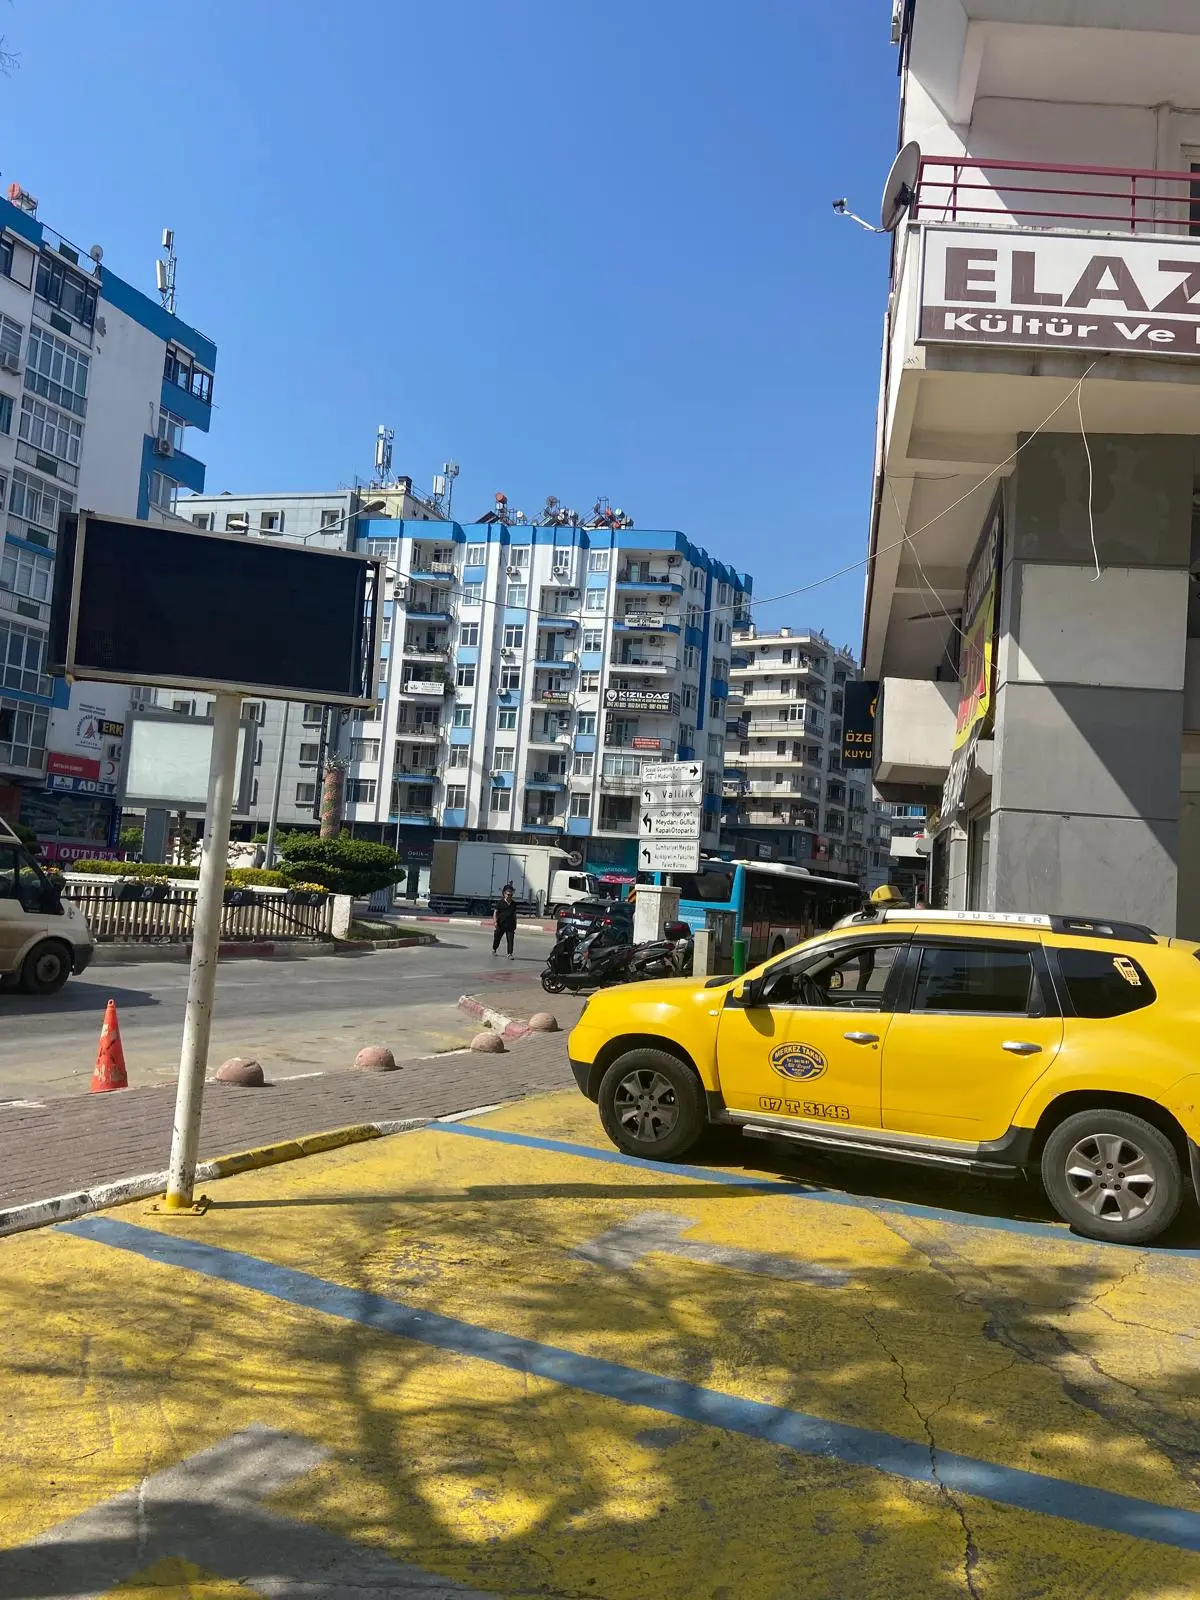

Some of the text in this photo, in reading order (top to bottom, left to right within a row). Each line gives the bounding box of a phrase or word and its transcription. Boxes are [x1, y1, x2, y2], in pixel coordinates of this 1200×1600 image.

[944, 312, 1176, 344] Kültür Ve
[846, 730, 872, 742] ÖZG
[845, 750, 872, 759] KUYU
[662, 789, 694, 799] Valilik
[660, 809, 693, 819] Cumhuriyet
[60, 848, 117, 860] OUTLET
[958, 912, 1042, 923] DUSTER
[774, 1046, 801, 1059] MERKEZ
[759, 1097, 850, 1119] 07 T 3146
